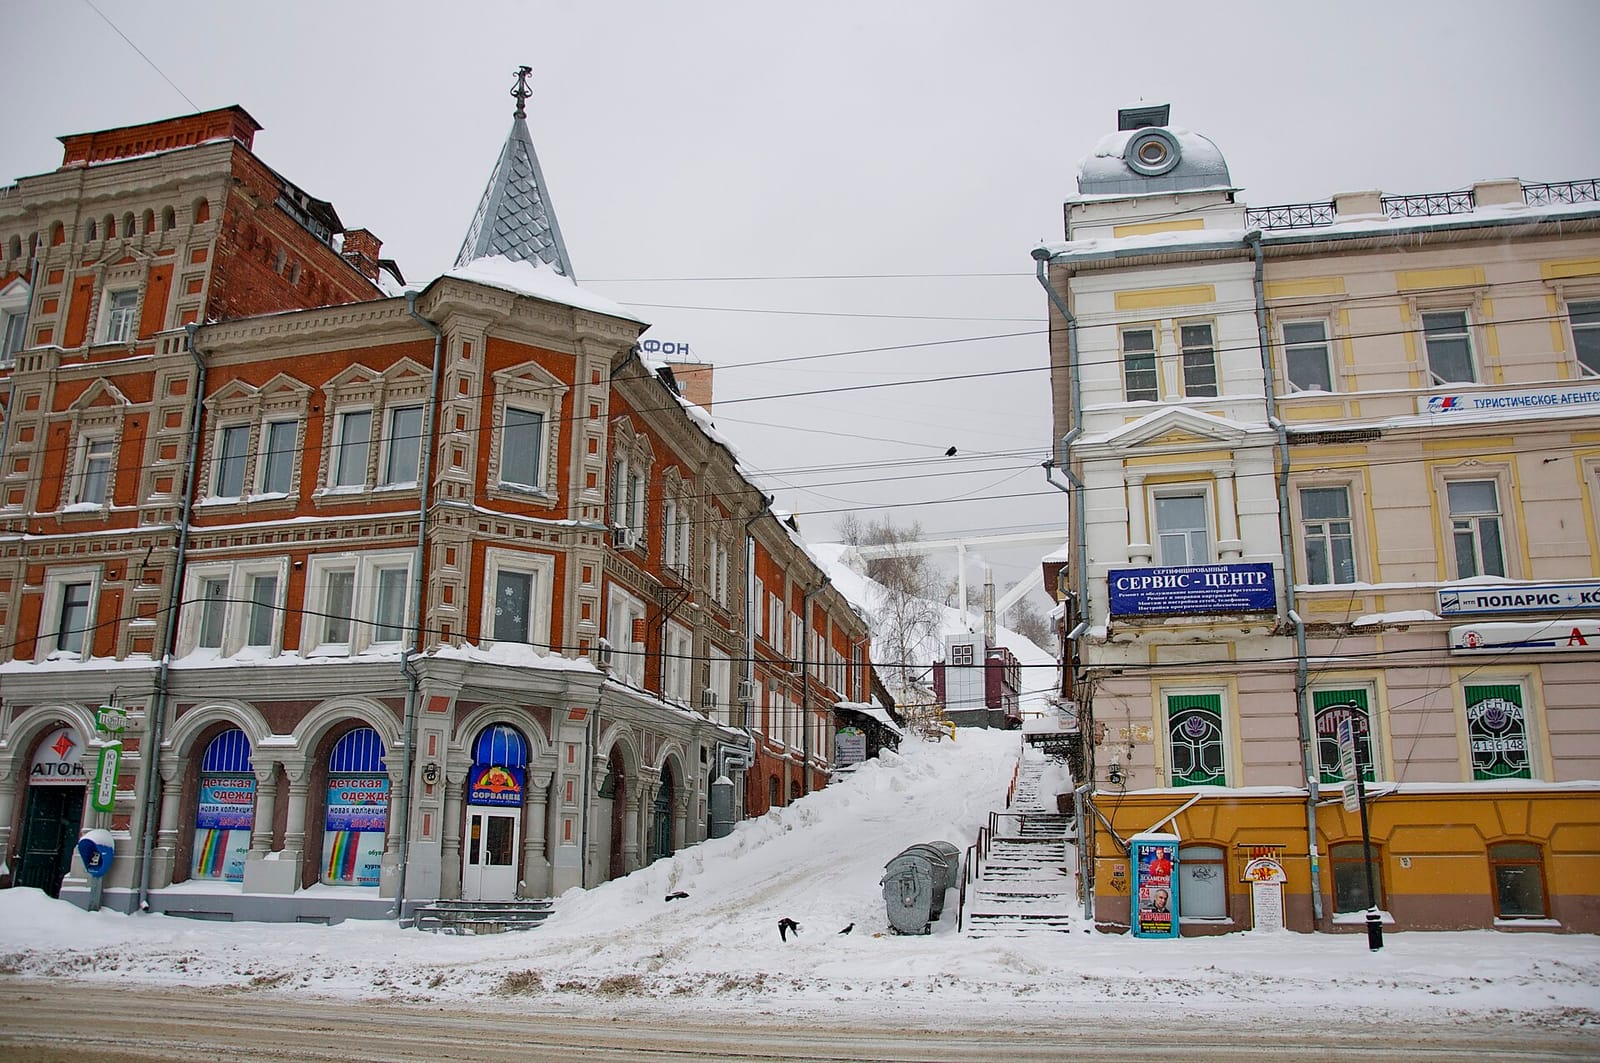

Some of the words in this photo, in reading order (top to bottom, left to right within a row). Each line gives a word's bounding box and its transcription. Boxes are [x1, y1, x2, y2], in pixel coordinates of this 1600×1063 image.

[1473, 395, 1558, 409] ТУРИСТИЧЕСКОЕ
[1561, 391, 1600, 404] АГЕНТС
[1153, 566, 1229, 575] СЕРТИФИЦИРОВАННЫЙ
[1117, 574, 1190, 591] СЕРВИС
[1205, 571, 1267, 588] ЦЕНТР
[1477, 593, 1561, 608] ПОЛАРИС
[1471, 698, 1522, 718] АРЕНДА
[1317, 709, 1368, 733] АПТА
[31, 762, 85, 776] АТОН
[102, 752, 116, 797] ЮРИСТЫ
[202, 778, 252, 788] детская
[328, 778, 382, 789] детская
[213, 790, 253, 801] одежд
[201, 805, 220, 813] новая
[1141, 888, 1150, 896] 24
